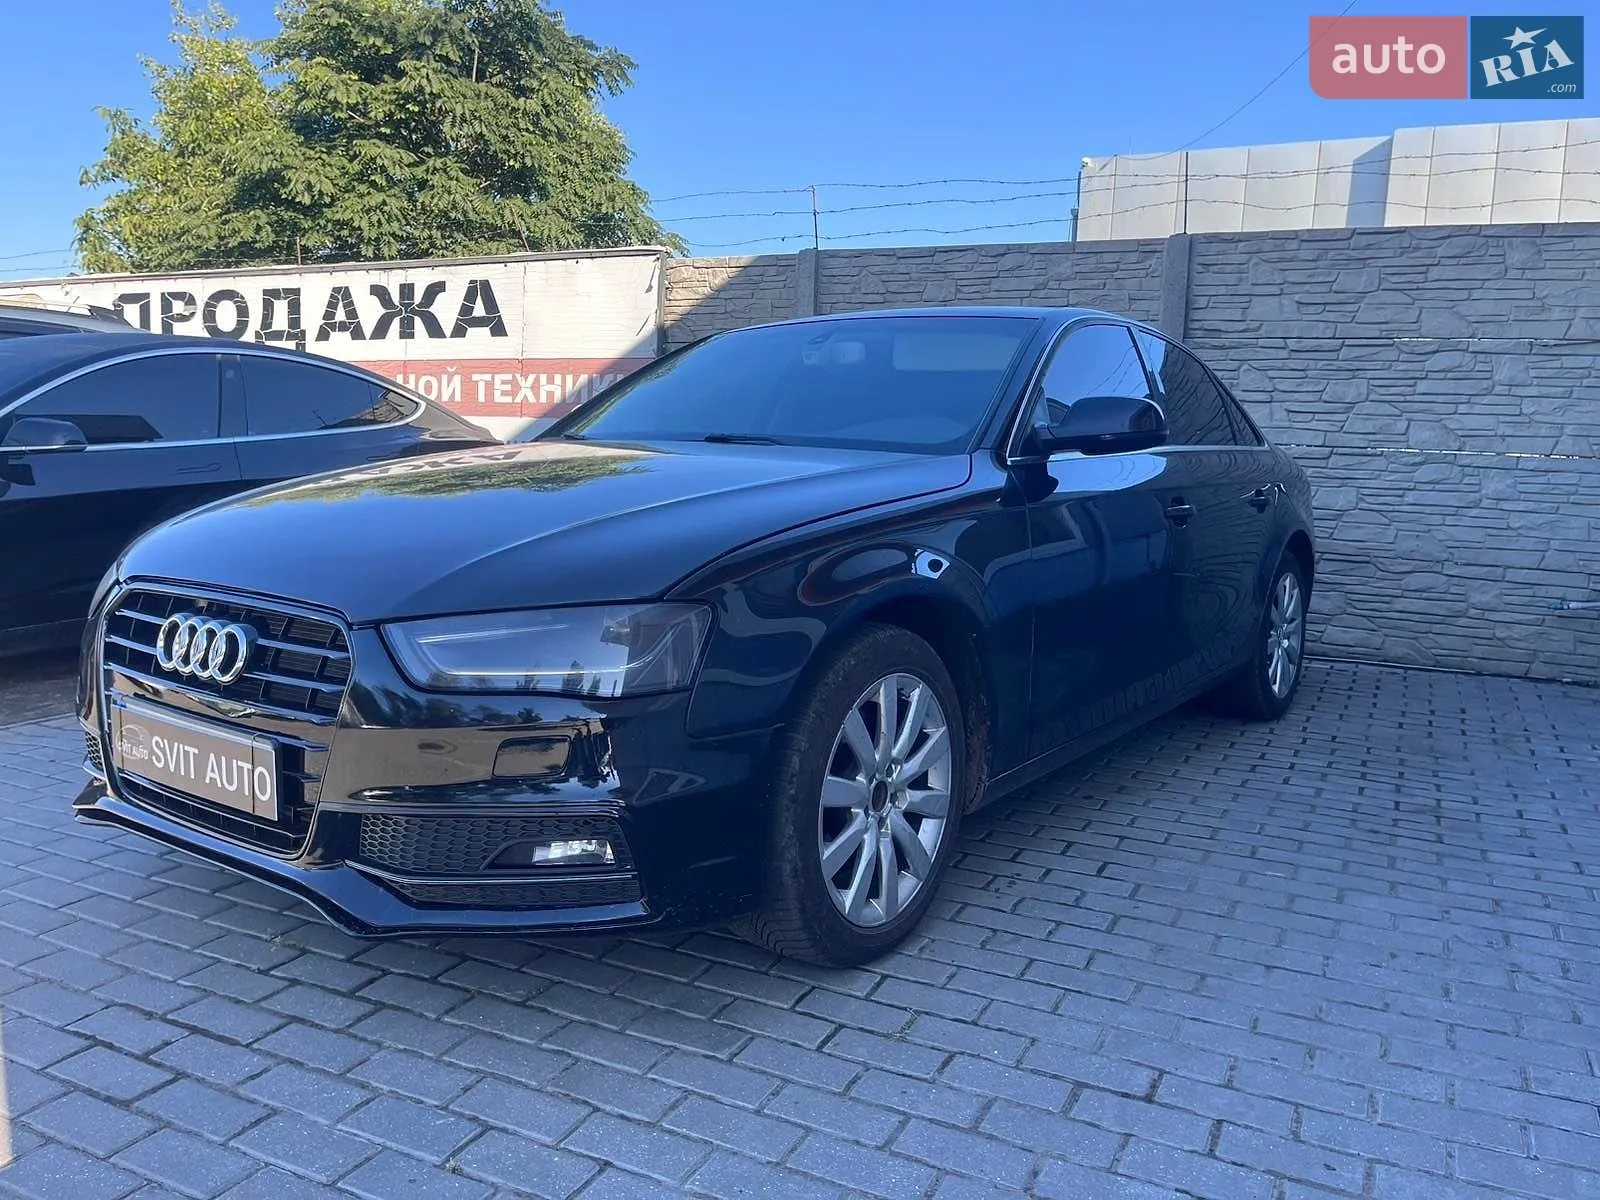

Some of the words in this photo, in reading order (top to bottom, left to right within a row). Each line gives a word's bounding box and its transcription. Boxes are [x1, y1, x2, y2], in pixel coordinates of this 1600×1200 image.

[114, 279, 508, 351] ПРОДАЖА
[151, 735, 199, 780] SVIT
[205, 752, 272, 802] AUTO
